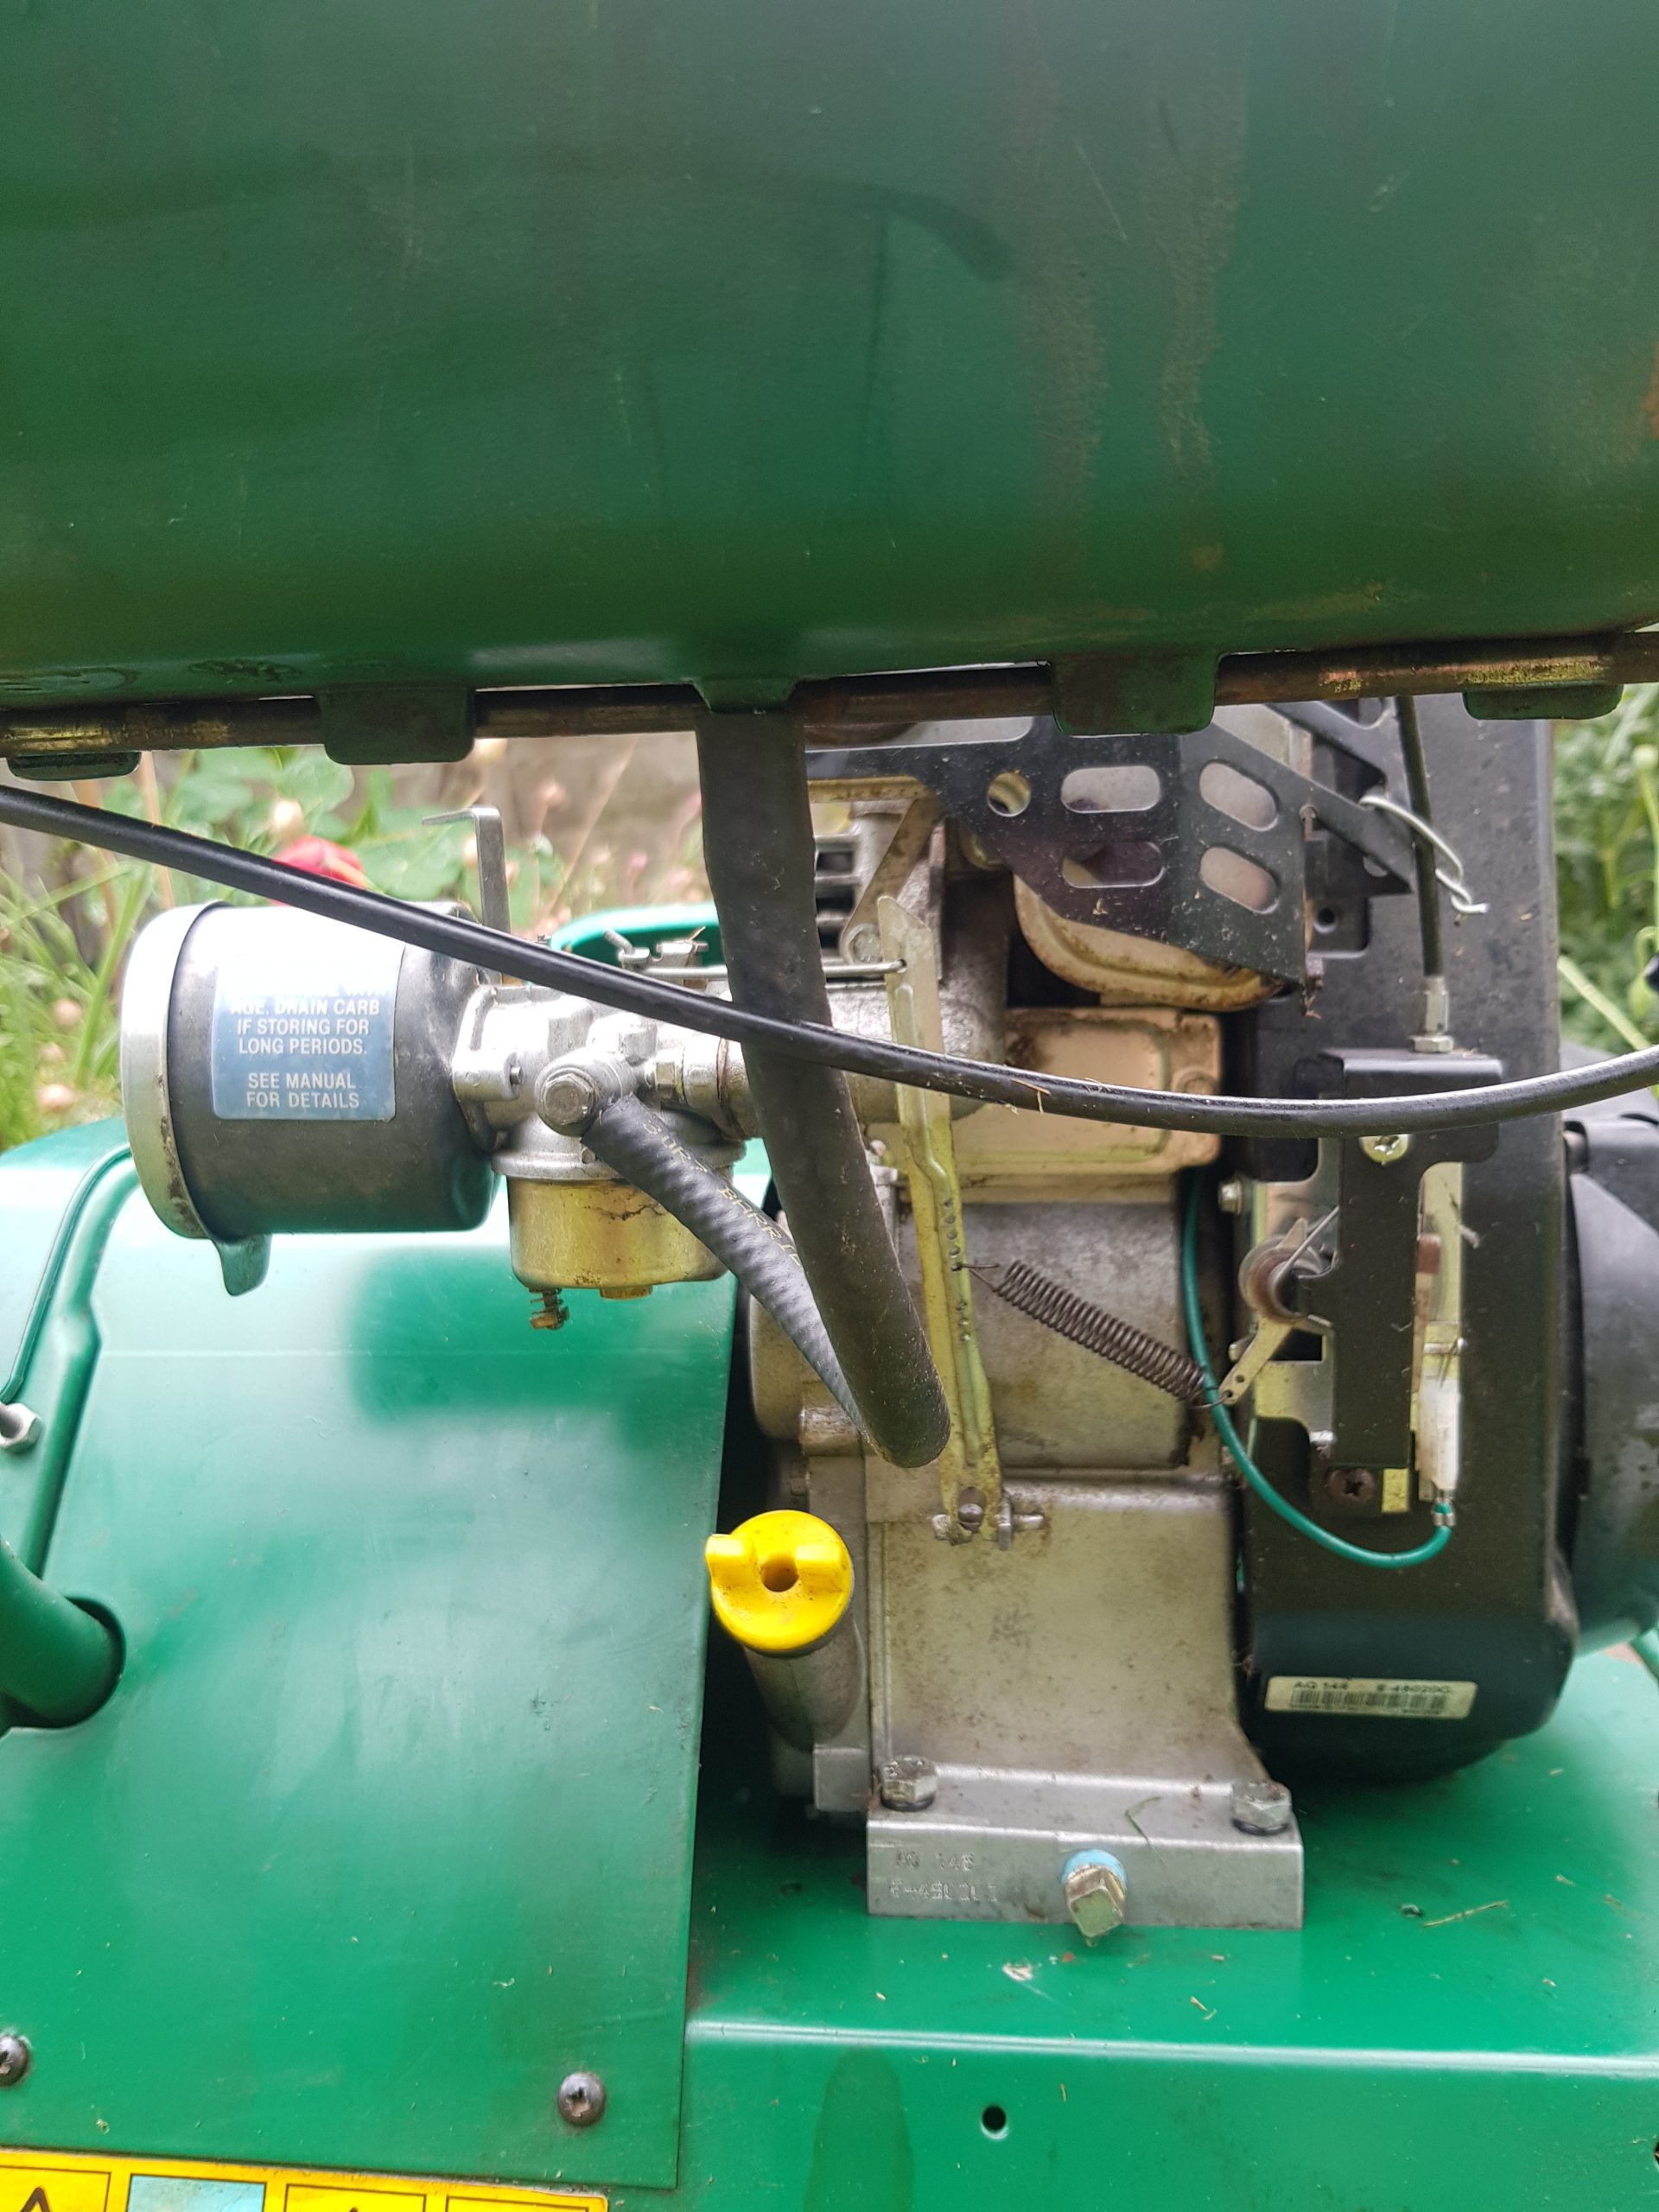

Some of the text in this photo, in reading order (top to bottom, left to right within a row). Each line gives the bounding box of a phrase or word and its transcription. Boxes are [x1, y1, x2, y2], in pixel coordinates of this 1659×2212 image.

[275, 999, 327, 1014] DRAIN
[334, 999, 379, 1015] CARB
[238, 1019, 369, 1035] IF STORING FOR
[238, 1039, 367, 1054] LONG PERIODS.
[248, 1073, 356, 1089] SEE MANUAL
[247, 1092, 359, 1108] FOR DETAILS
